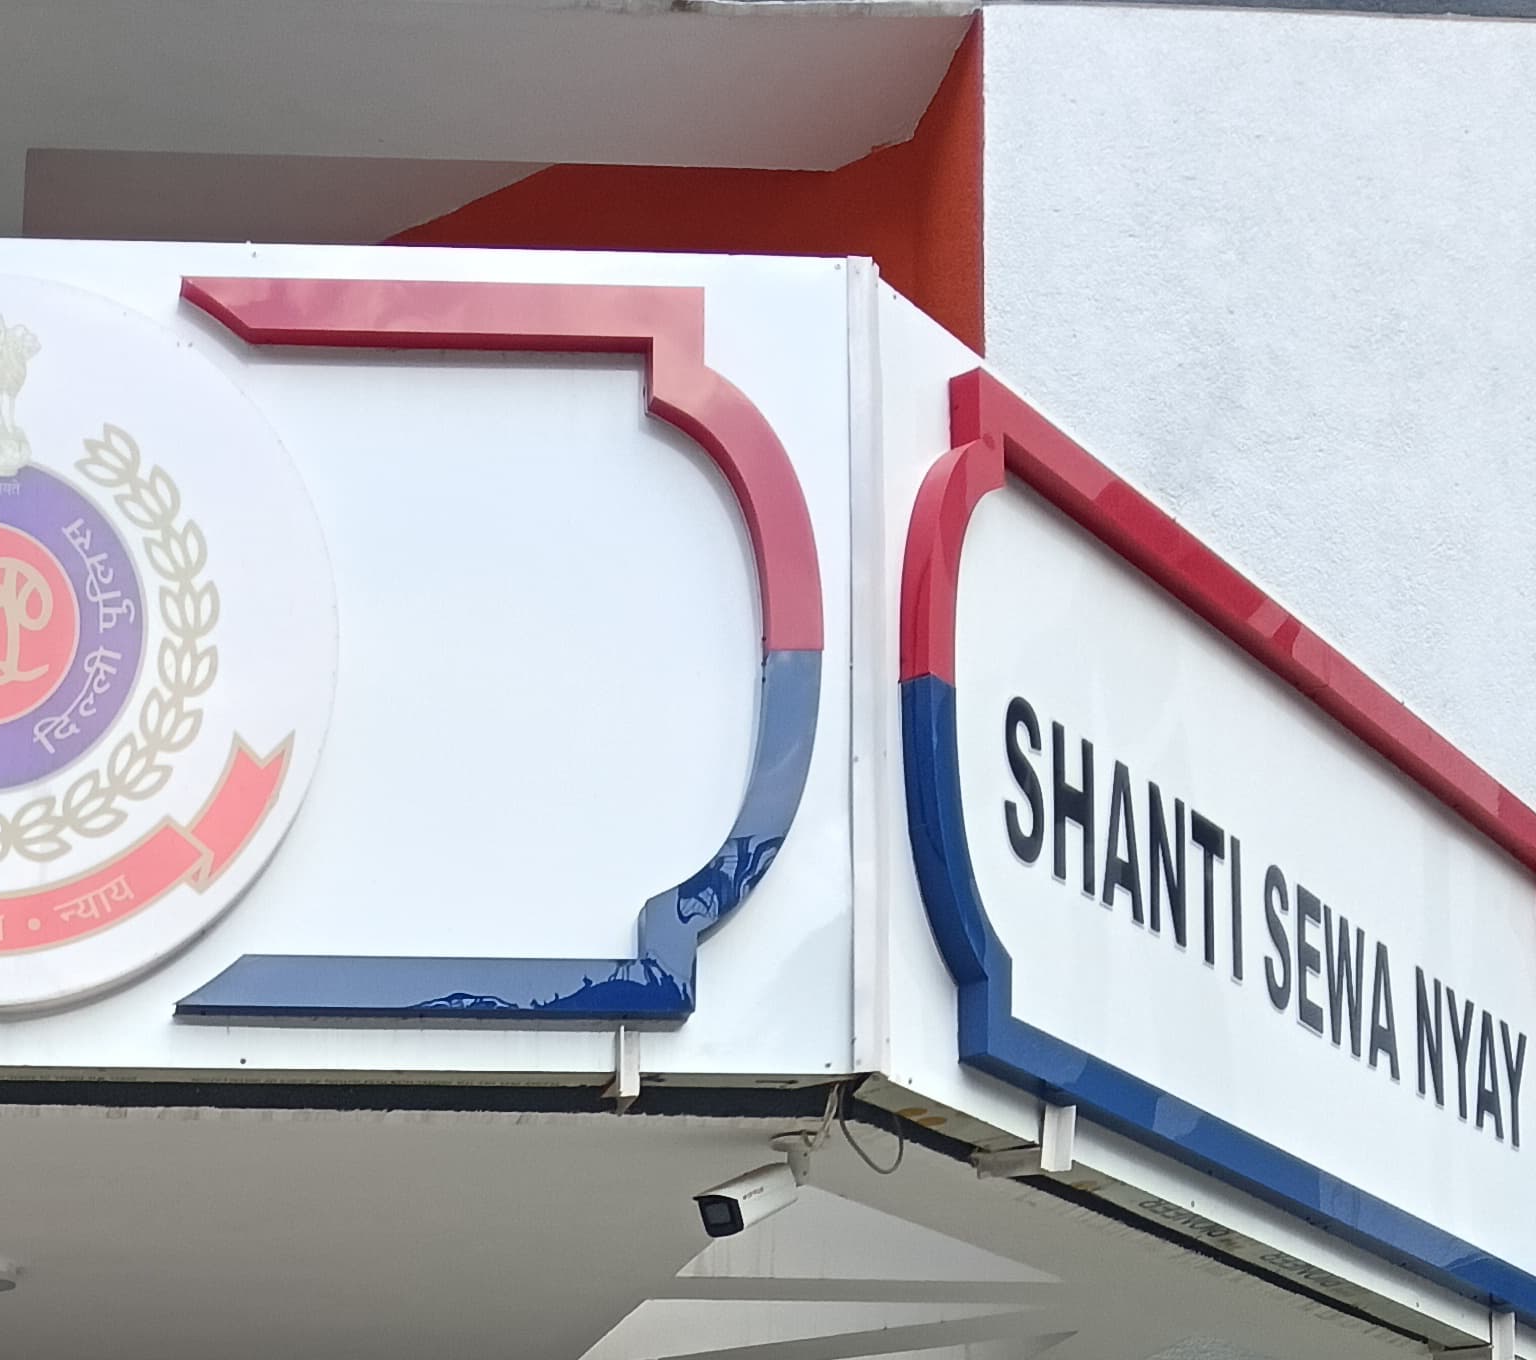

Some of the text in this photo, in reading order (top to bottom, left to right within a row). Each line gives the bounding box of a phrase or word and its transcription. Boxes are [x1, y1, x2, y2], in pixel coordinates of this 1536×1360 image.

[33, 518, 136, 754] दिल्ली पुलिस
[53, 874, 135, 923] न्याय
[1004, 696, 1527, 1148] SHANTI SEWA NYAY
